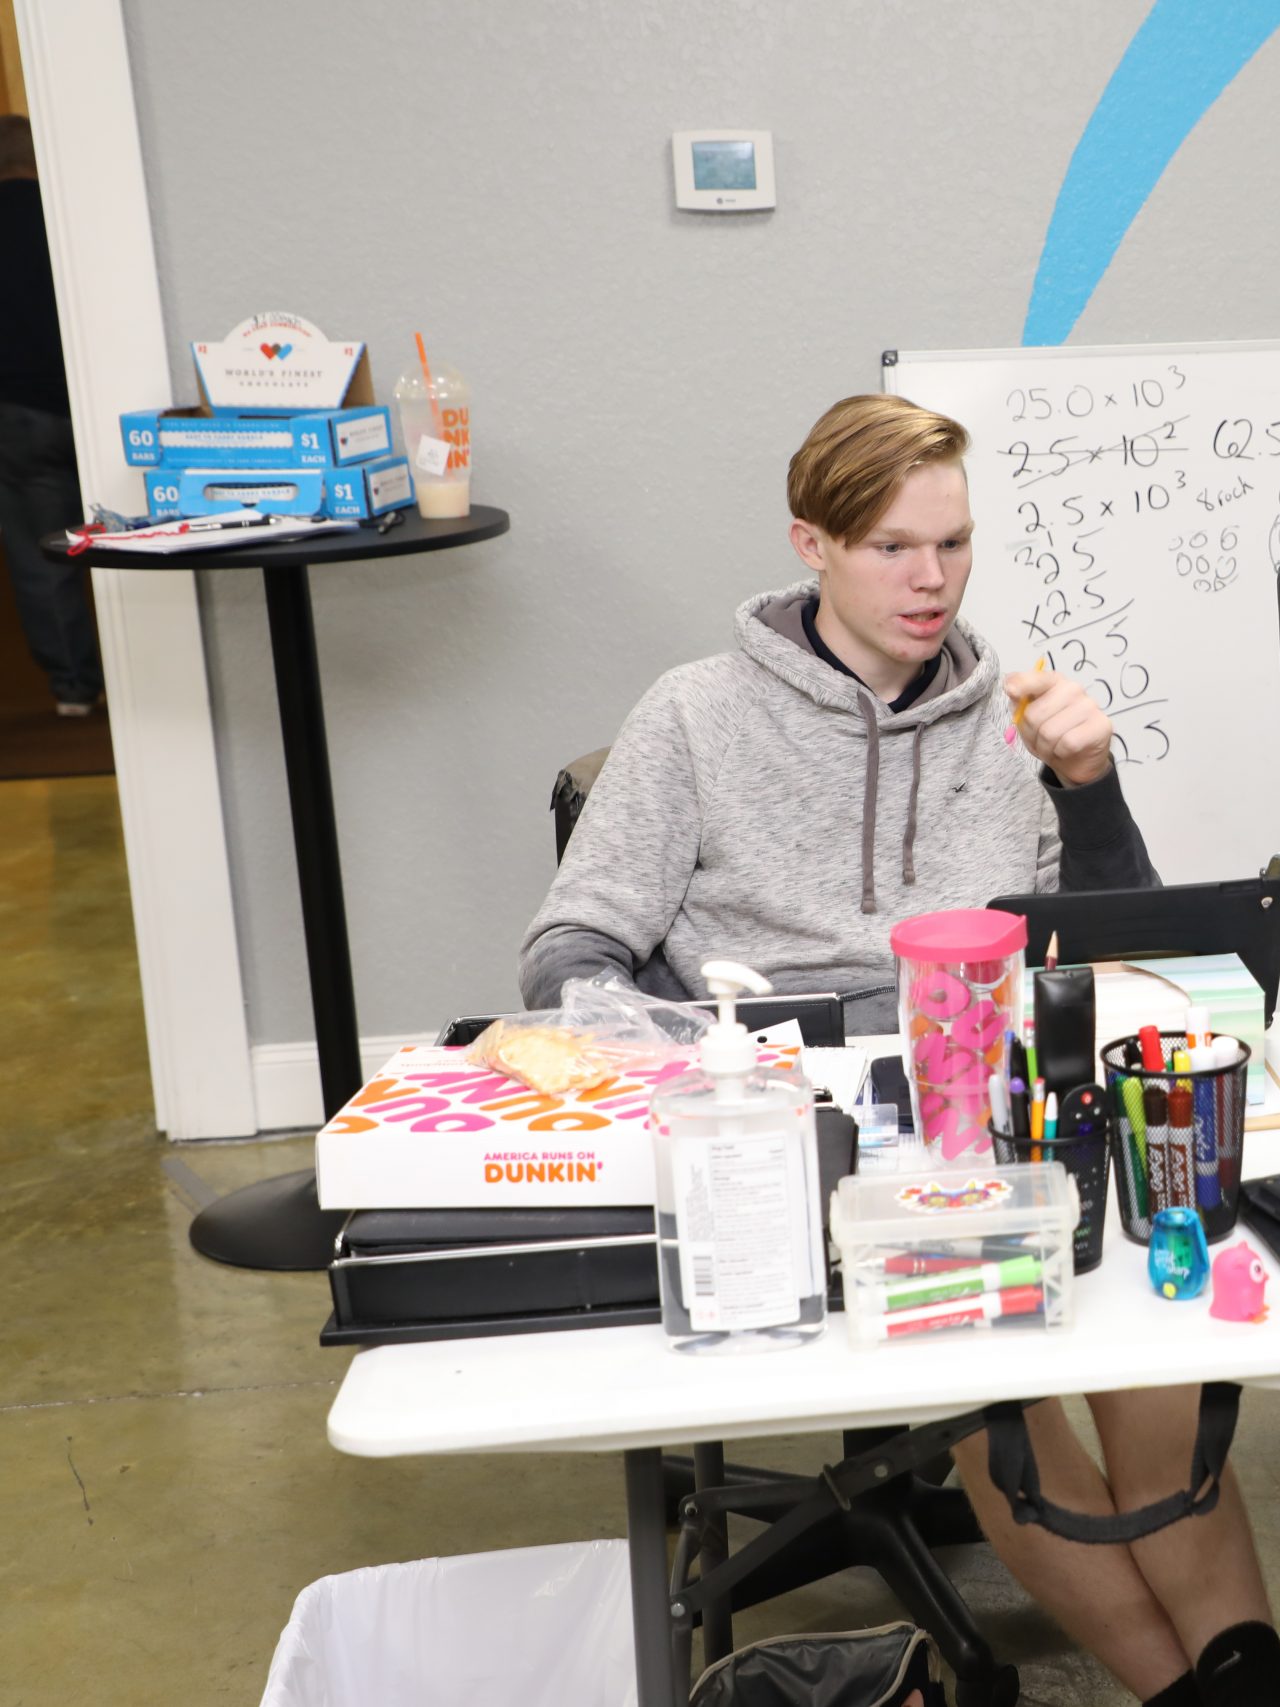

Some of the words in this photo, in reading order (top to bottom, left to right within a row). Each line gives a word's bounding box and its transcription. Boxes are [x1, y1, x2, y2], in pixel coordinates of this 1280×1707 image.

[129, 430, 153, 446] 60
[301, 432, 319, 449] $1
[132, 453, 155, 461] BARS
[301, 454, 326, 463] EACH
[153, 486, 178, 502] 60
[335, 483, 354, 500] $1
[335, 505, 360, 514] EACH
[484, 1151, 538, 1161] AMERICA
[541, 1151, 573, 1160] RUNS
[577, 1150, 595, 1160] ON
[484, 1160, 603, 1184] DUNKIN'
